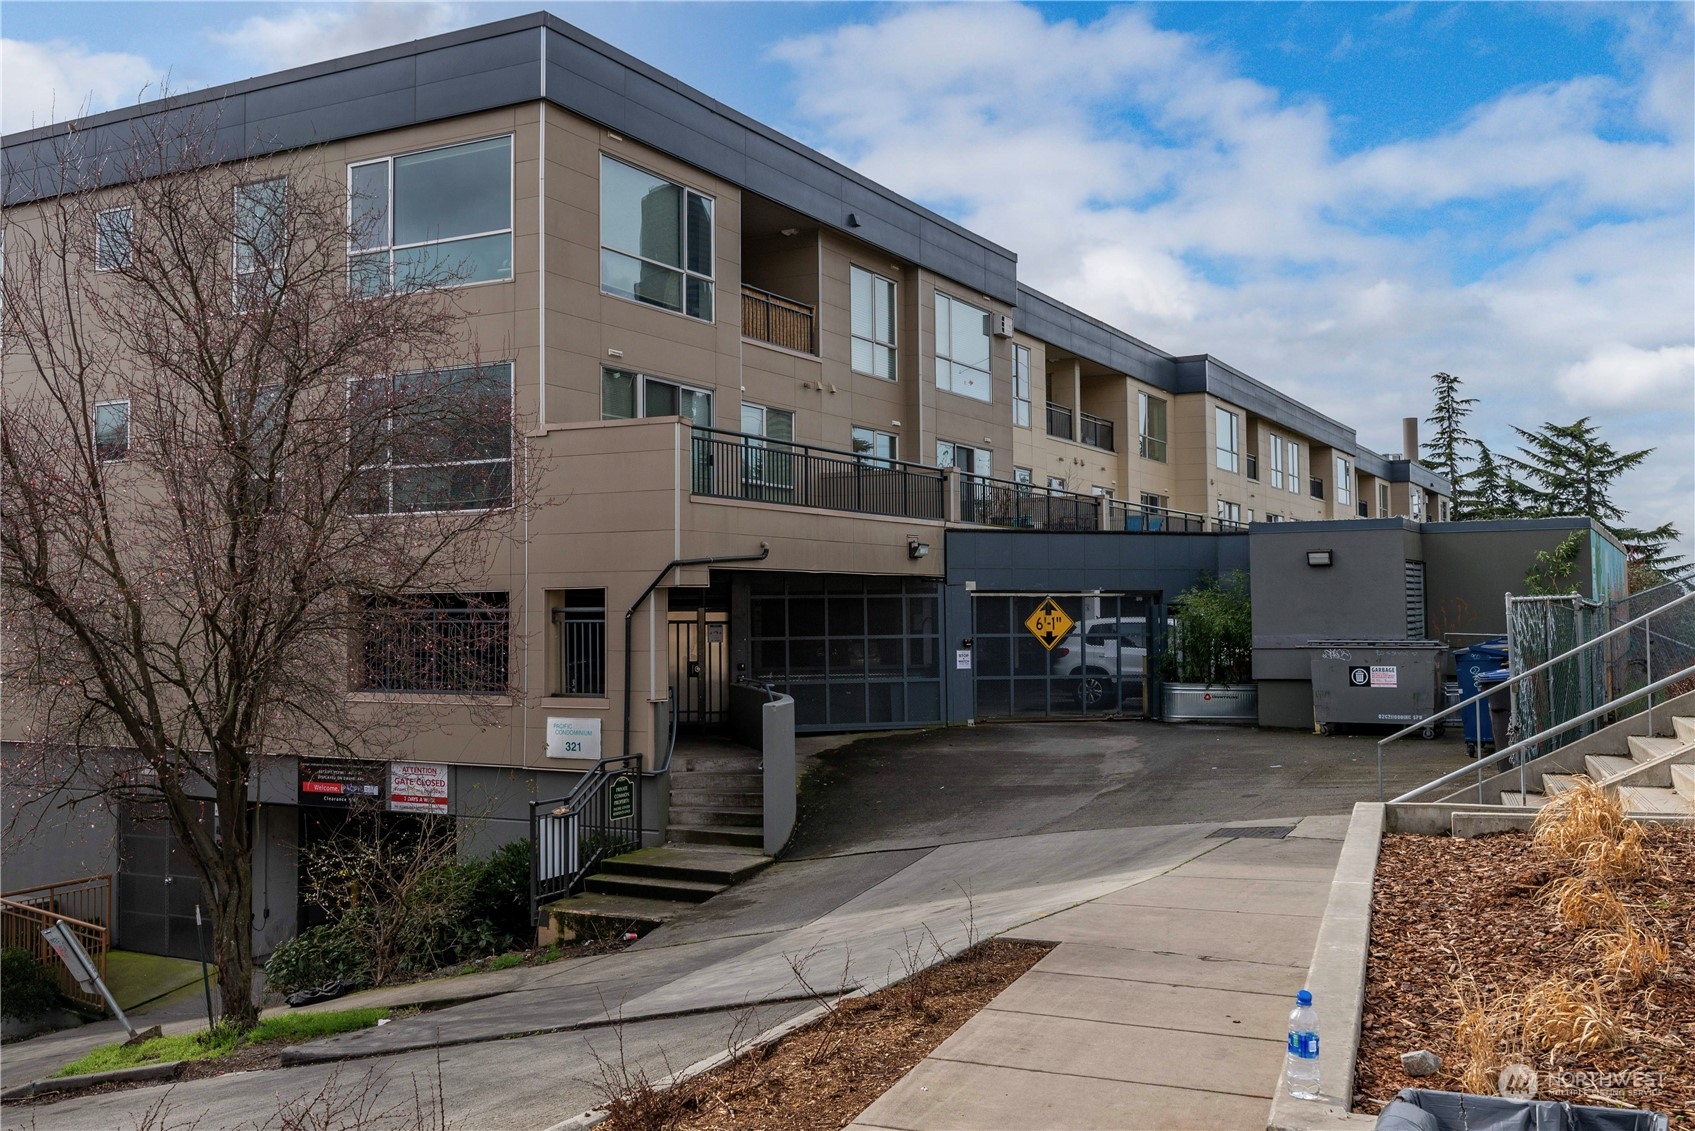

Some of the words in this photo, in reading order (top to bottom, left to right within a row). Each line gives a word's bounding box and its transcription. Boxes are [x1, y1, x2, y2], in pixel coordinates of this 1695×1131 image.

[1035, 616, 1062, 631] 6'-1"
[565, 741, 581, 752] 321
[402, 766, 437, 775] ATTENTION
[394, 777, 414, 786] GATE
[416, 778, 446, 787] CLOSED
